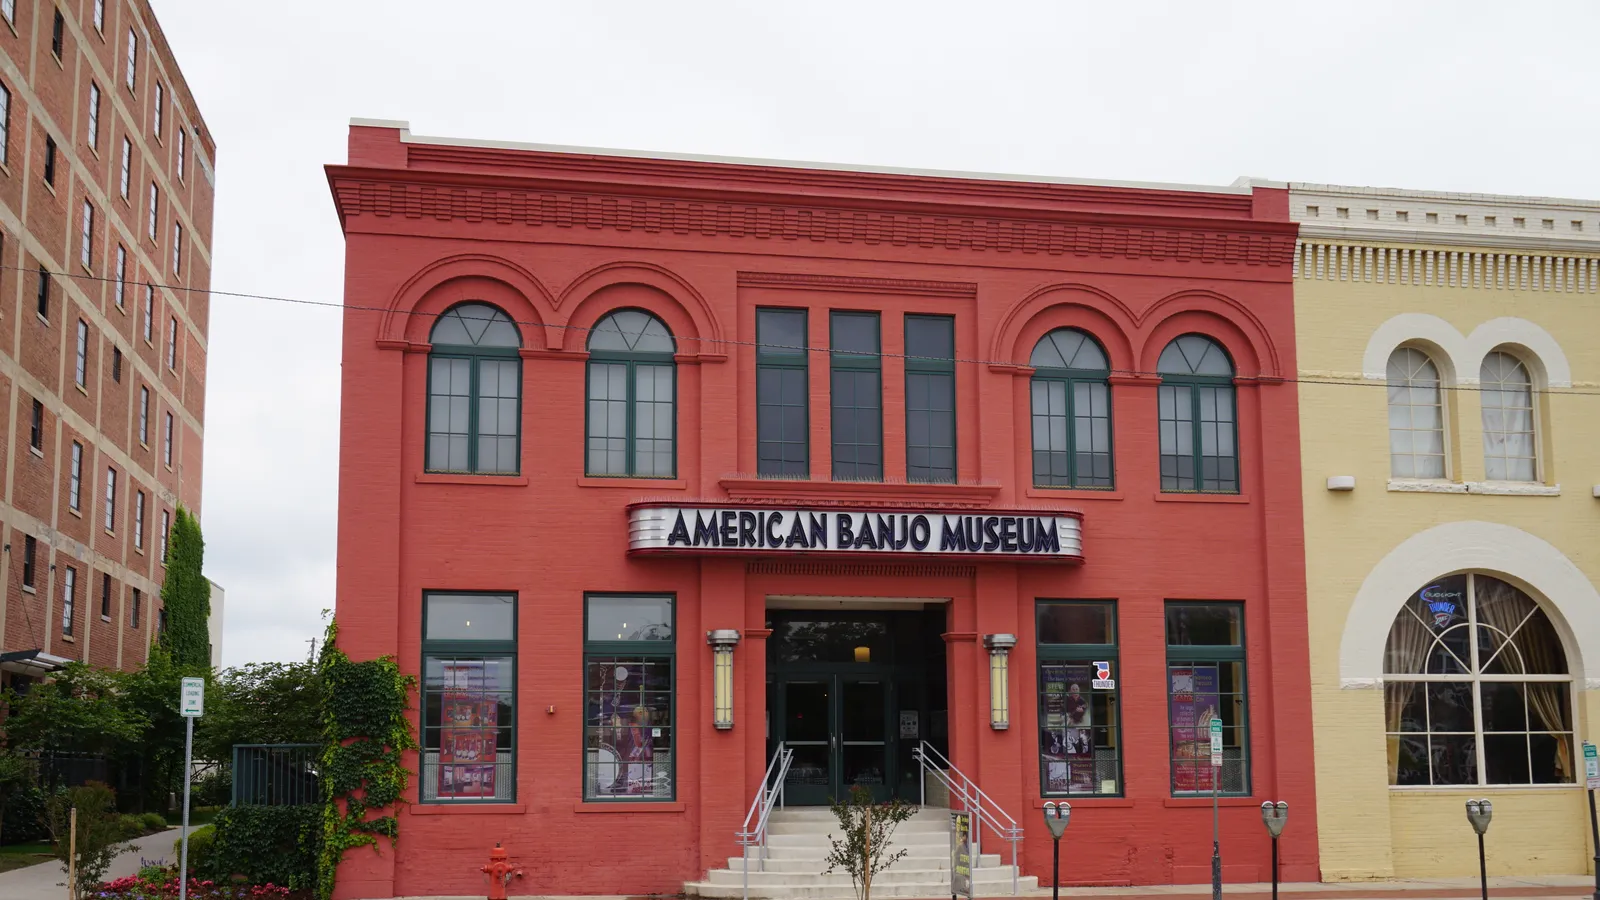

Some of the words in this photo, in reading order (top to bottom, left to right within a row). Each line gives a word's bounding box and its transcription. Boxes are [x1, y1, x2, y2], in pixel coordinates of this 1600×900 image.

[667, 508, 828, 549] AMERICAN
[836, 512, 931, 551] BANJO
[940, 515, 1060, 553] MUSEUM
[1428, 602, 1456, 614] THUNDER
[1093, 680, 1114, 688] THUNDER
